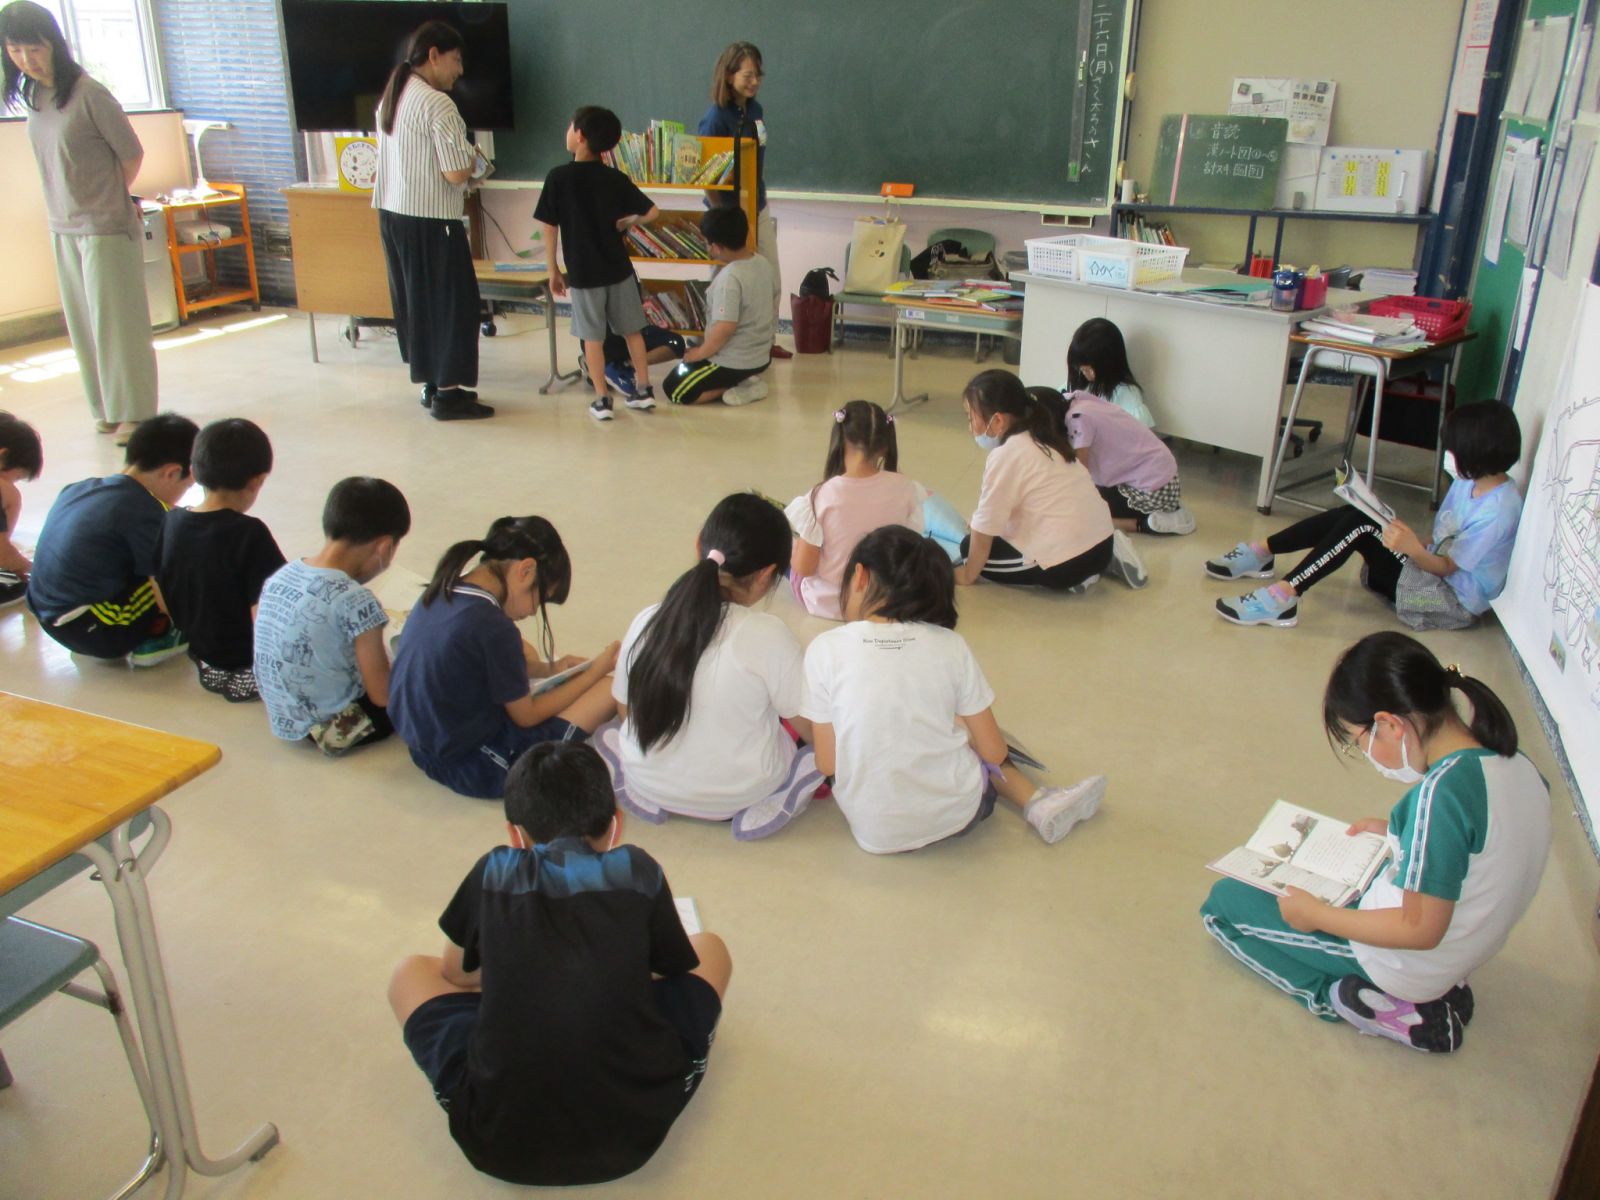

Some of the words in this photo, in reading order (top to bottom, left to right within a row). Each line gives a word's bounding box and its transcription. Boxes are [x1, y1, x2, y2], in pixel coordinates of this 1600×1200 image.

[1301, 563, 1319, 580] LOVE
[1331, 541, 1349, 558] LOVE
[270, 581, 303, 603] NEVER
